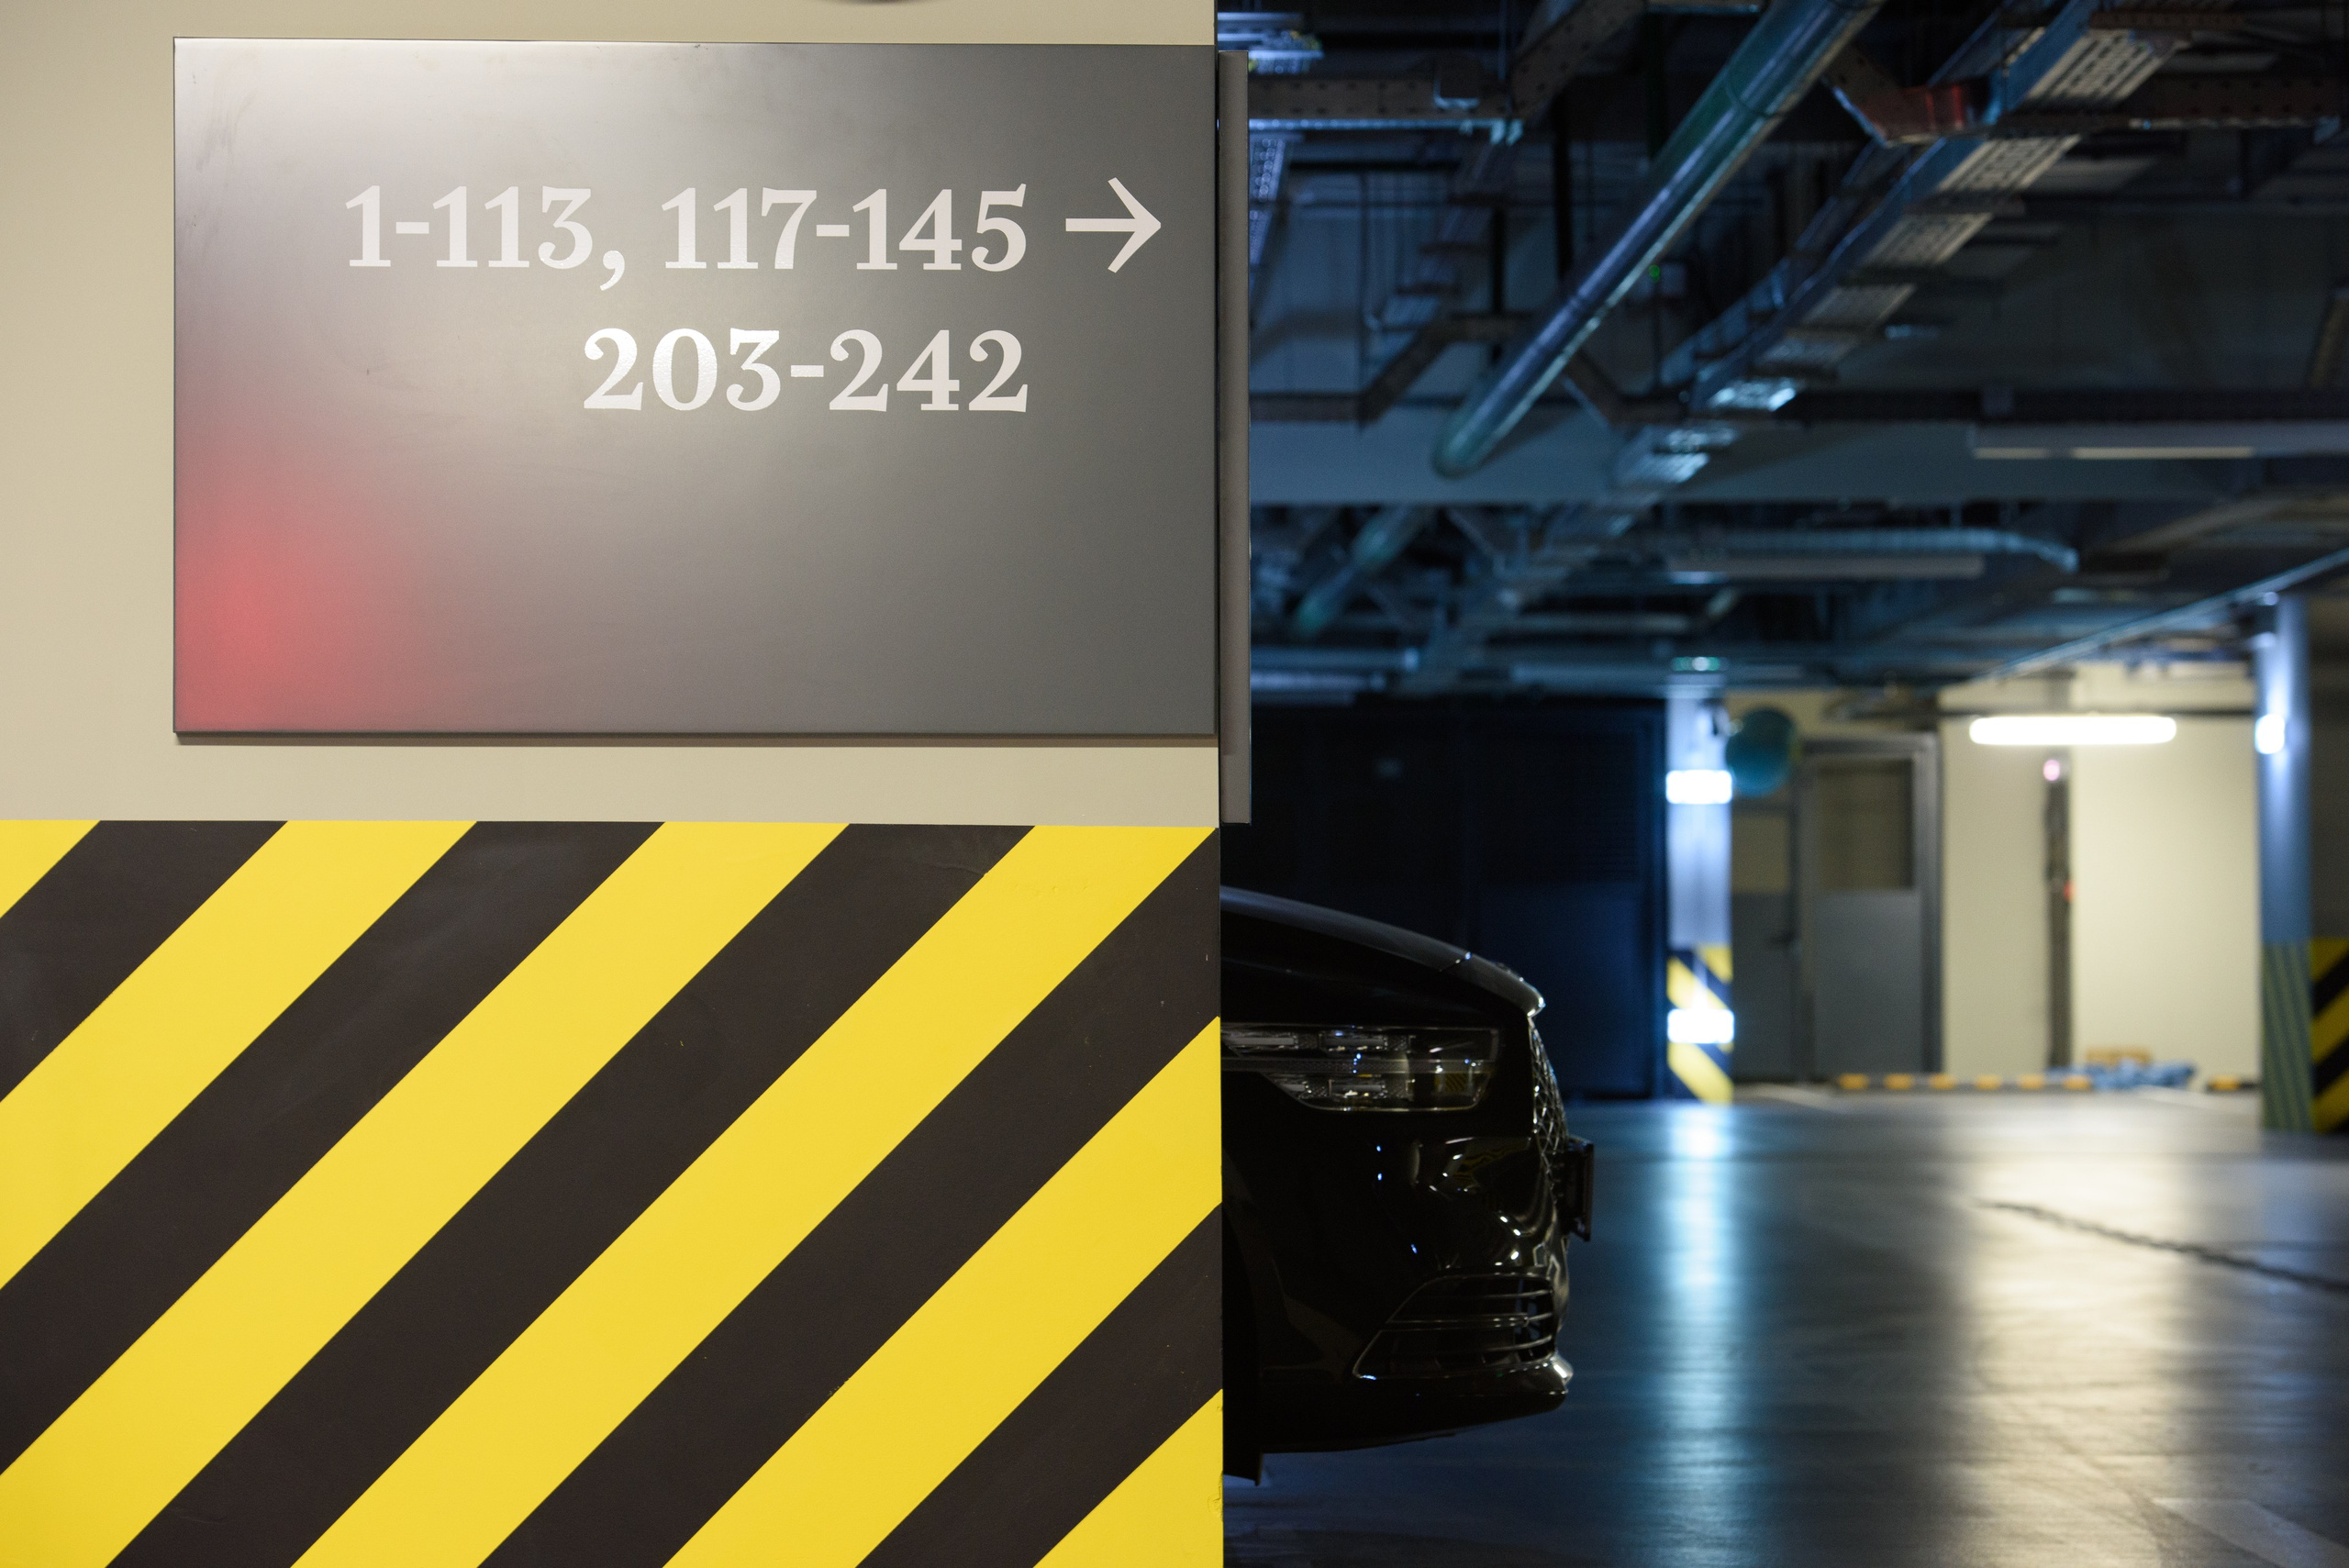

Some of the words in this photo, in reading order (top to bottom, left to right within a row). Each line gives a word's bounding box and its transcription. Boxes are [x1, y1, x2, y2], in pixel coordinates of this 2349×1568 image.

[345, 185, 625, 292] 1-113,
[662, 183, 1028, 272] 117-145
[584, 328, 1029, 413] 203-242
